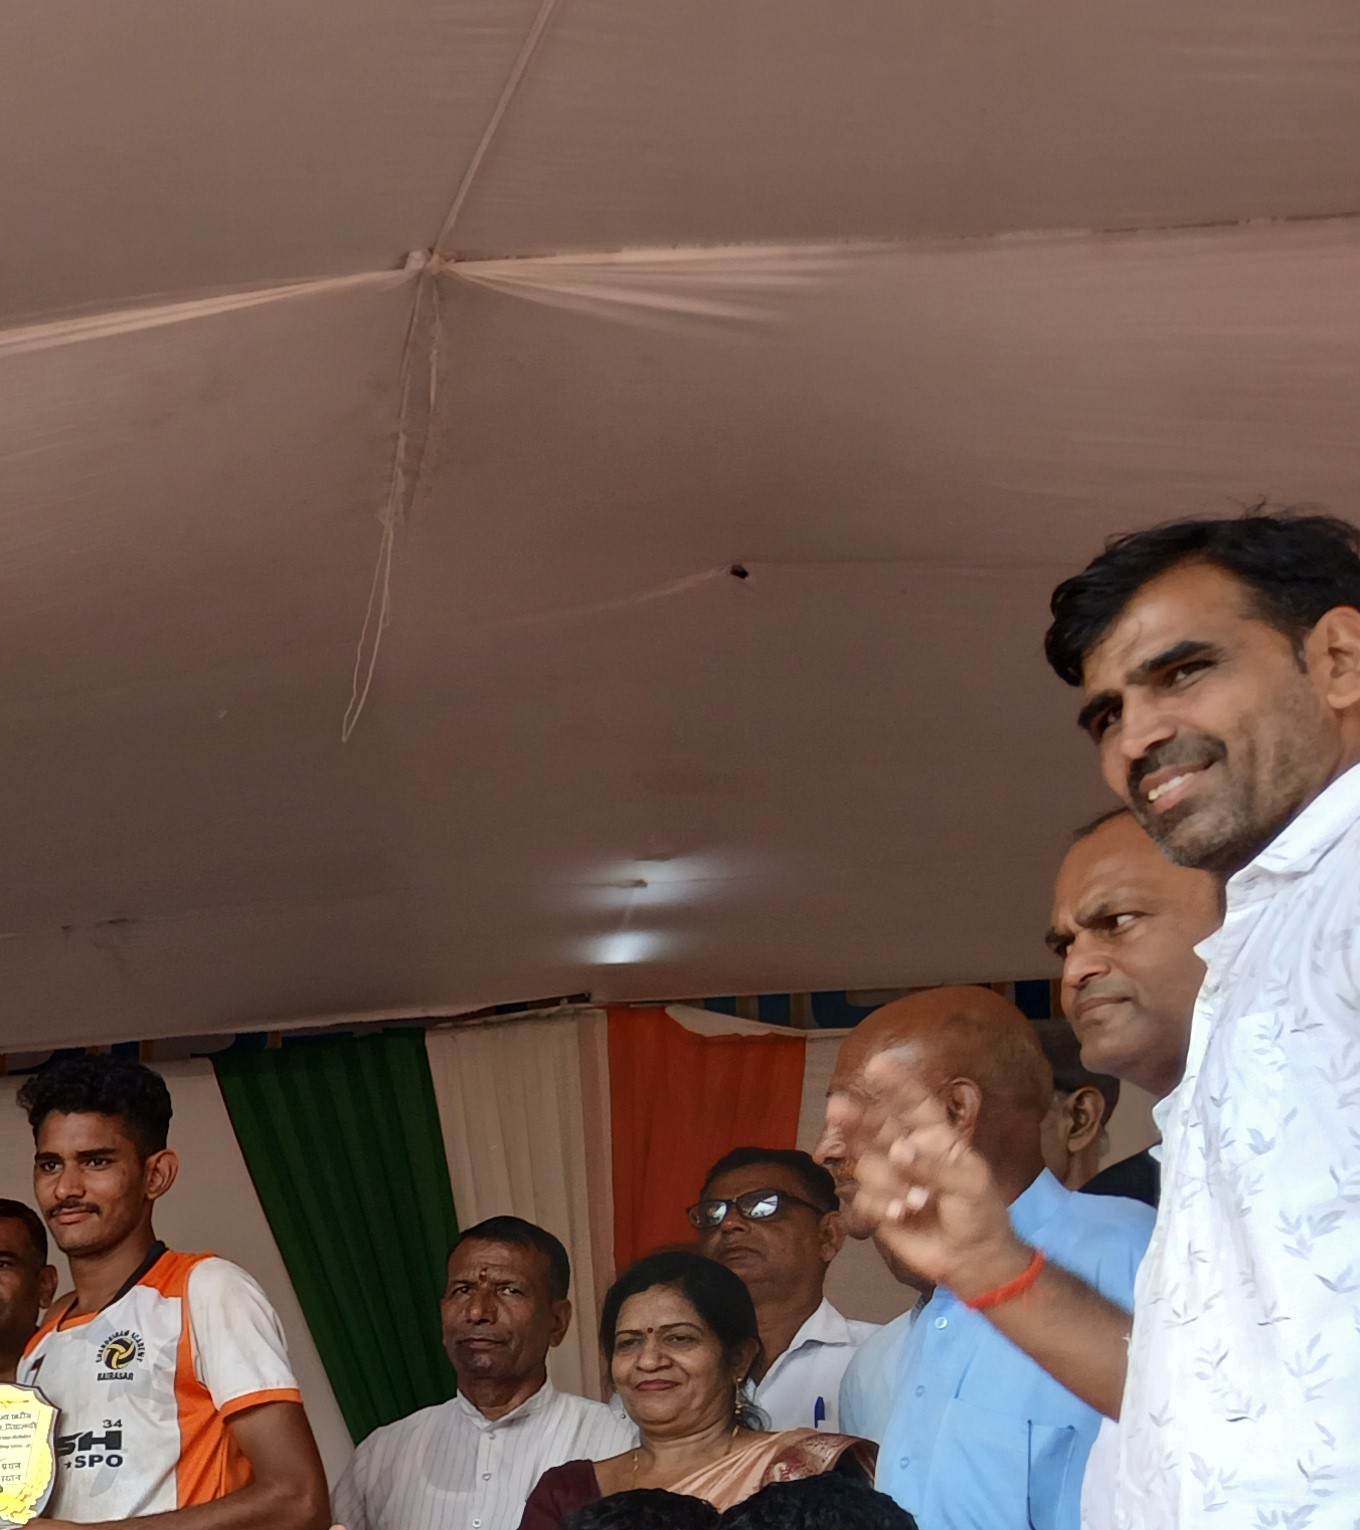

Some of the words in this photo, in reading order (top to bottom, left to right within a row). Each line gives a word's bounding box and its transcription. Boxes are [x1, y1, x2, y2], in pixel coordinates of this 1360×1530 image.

[102, 1419, 122, 1429] 34
[58, 1430, 122, 1456] SH
[74, 1455, 123, 1468] SPO
